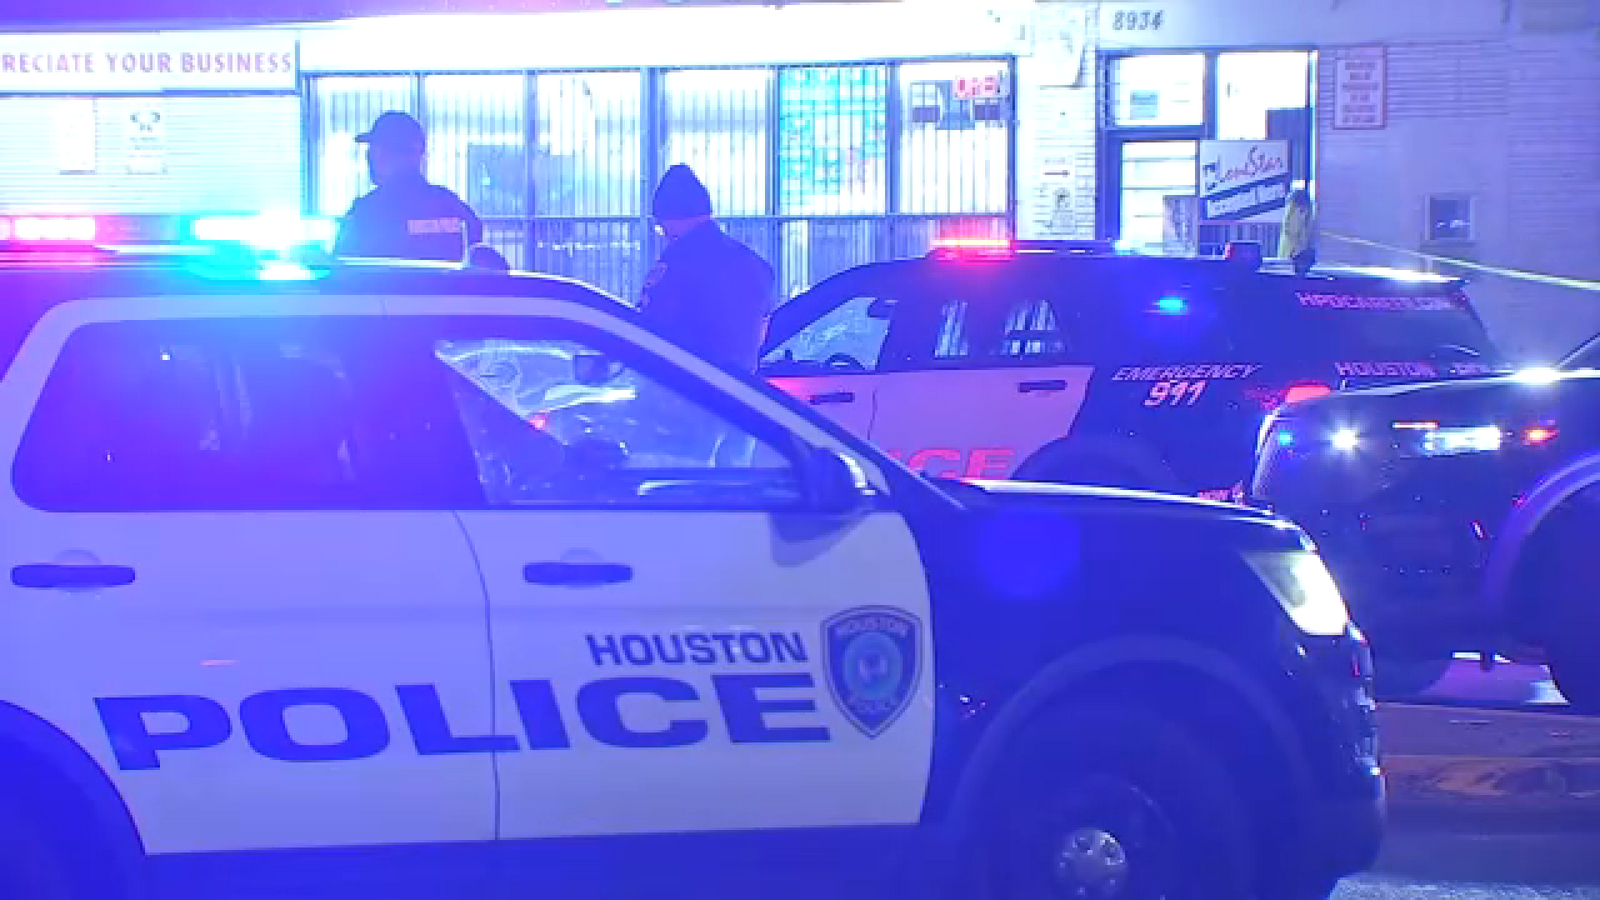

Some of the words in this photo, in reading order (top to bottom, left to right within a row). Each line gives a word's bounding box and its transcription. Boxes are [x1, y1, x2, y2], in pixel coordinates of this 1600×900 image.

[1112, 9, 1166, 31] 8934
[1, 52, 95, 74] RECIATE
[106, 52, 172, 74] YOUR
[180, 52, 292, 74] BUSINESS
[1111, 362, 1263, 382] EMERGENCY
[1143, 379, 1208, 407] 911
[585, 631, 809, 666] HOUSTON
[92, 671, 832, 771] POLICE
